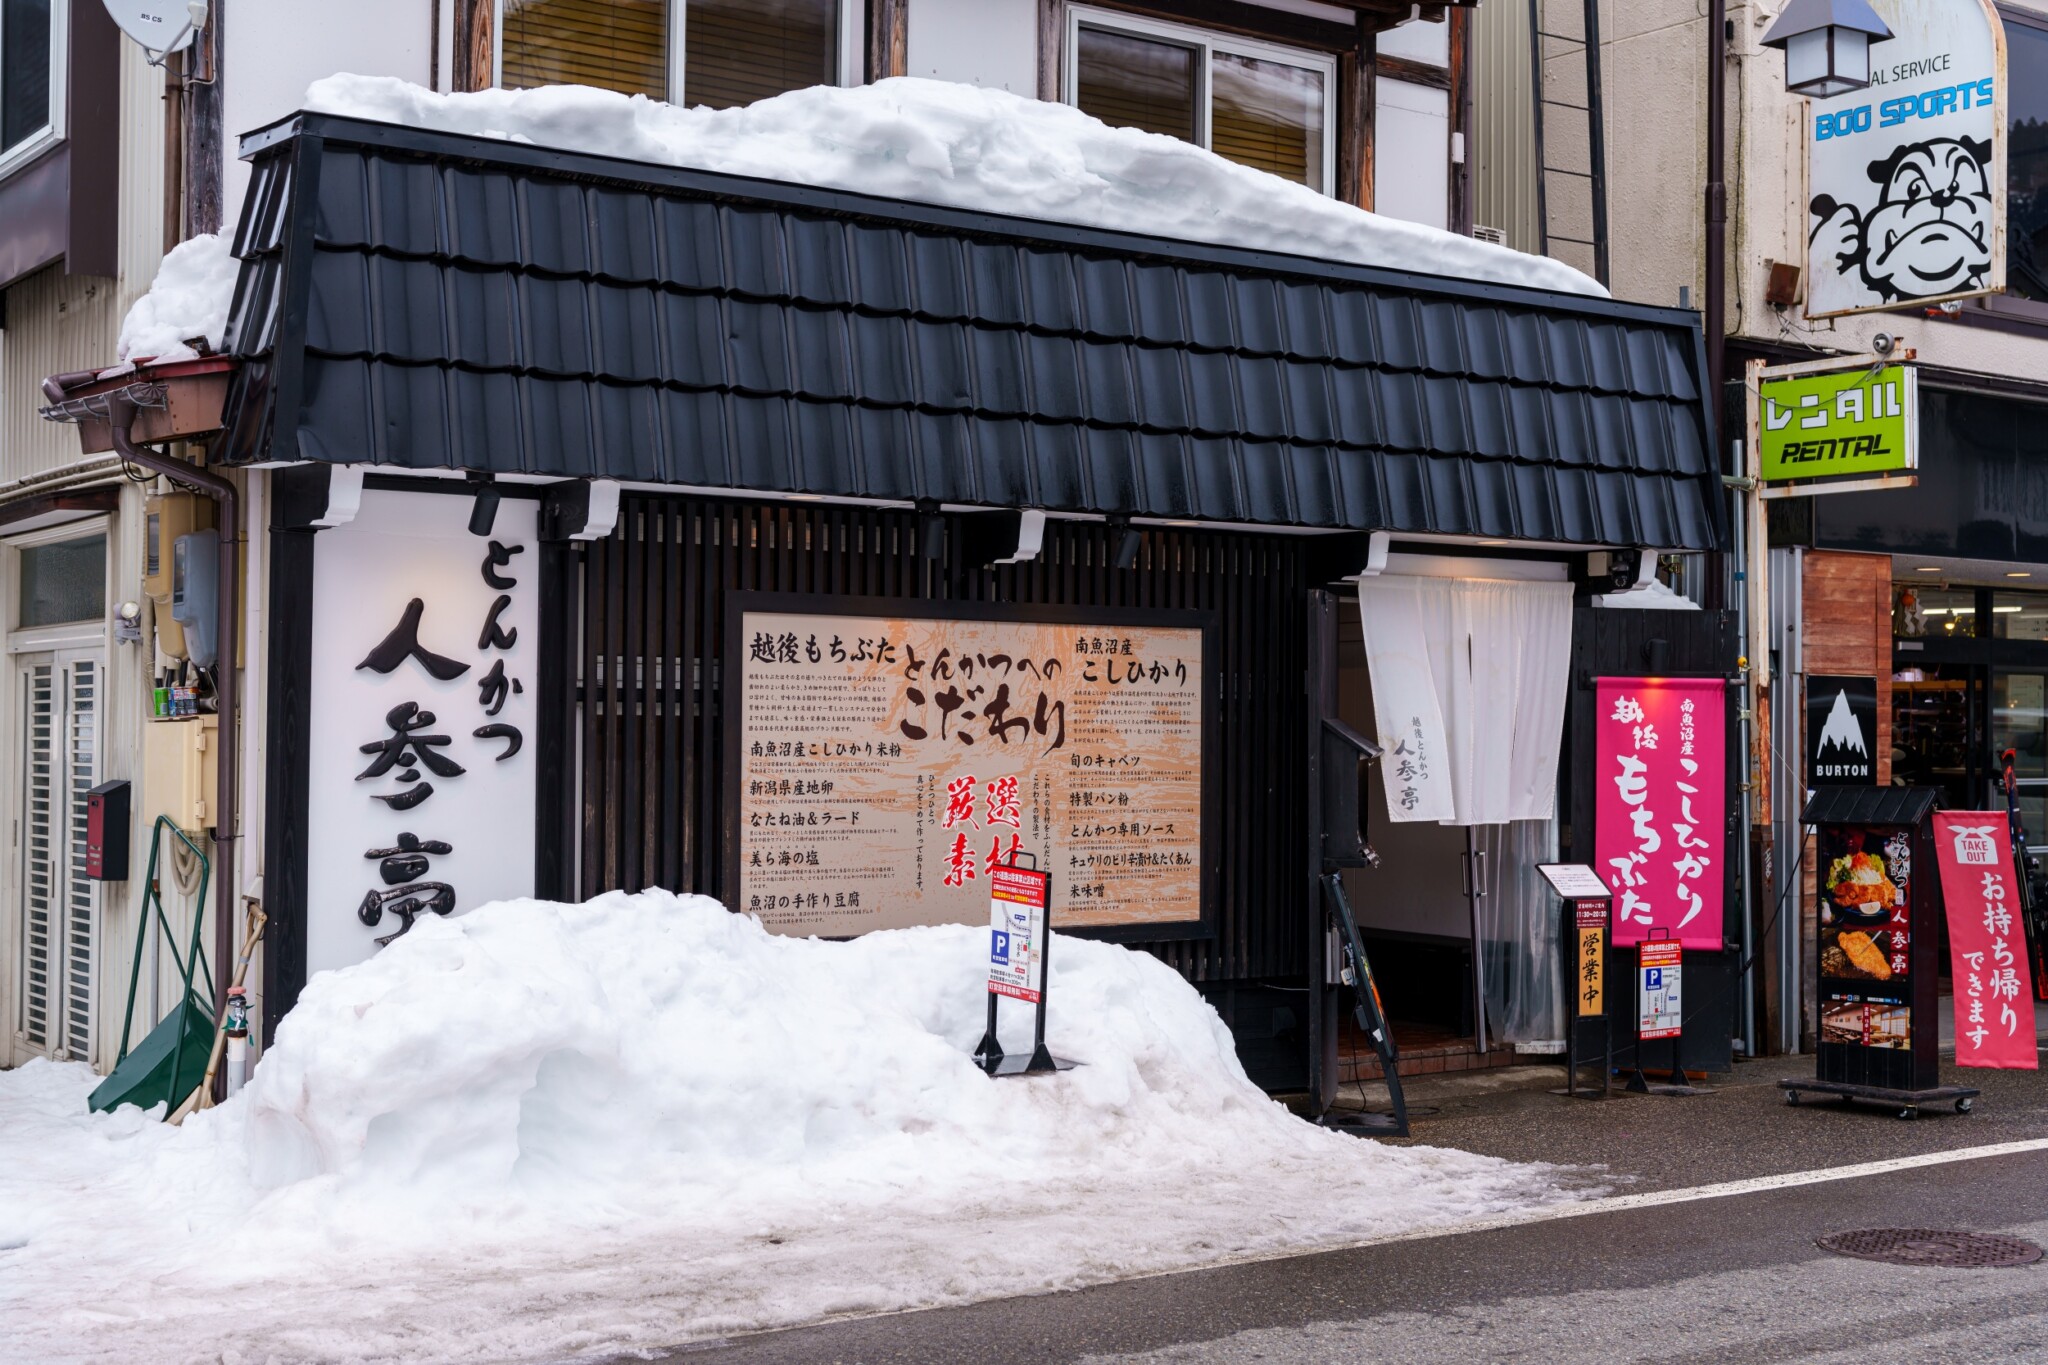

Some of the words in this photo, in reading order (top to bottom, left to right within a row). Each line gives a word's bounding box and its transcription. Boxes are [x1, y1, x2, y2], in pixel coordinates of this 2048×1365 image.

[1869, 70, 1889, 87] AL
[1892, 53, 1951, 82] SERVICE
[1815, 105, 1872, 141] BOO
[1880, 77, 1993, 128] SPORTS
[1766, 381, 1901, 431] レンタル
[1780, 433, 1891, 464] RENTAL
[473, 540, 525, 761] とんかつ
[749, 632, 896, 664] 越後もちぶた
[1075, 636, 1133, 655] 南魚沼産
[904, 644, 1062, 681] とんかつへの
[1082, 658, 1187, 687] こしひかり
[900, 683, 1065, 758] こだわり
[751, 741, 901, 757] 南魚沼産こしひかり米粉
[1071, 753, 1140, 768] 旬のキャベツ
[1412, 716, 1428, 780] 越後とんかつ
[354, 597, 471, 948] 人参亭
[1393, 739, 1419, 810] 人参亭
[1816, 764, 1868, 777] BURTON
[750, 779, 833, 796] 新潟県産地卵
[927, 774, 935, 825] ひとつひとつ
[1069, 791, 1129, 807] 特製パン粉
[1609, 695, 1661, 925] 越後もちぶた
[915, 774, 925, 891] 真心をこめて作っております。
[1071, 822, 1175, 837] とんかつ専用ソース
[1961, 840, 1989, 851] TAKE
[750, 850, 820, 867] 美ら海の塩
[1966, 851, 1987, 862] OUT
[749, 891, 860, 910] 魚沼の手作り豆腐
[1070, 884, 1105, 899] 米味噌
[996, 935, 1007, 953] P
[1891, 910, 1908, 973] 人参亭
[1980, 871, 2022, 1037] お持ち帰り
[1582, 932, 1600, 1009] 営業中
[1650, 970, 1658, 984] P
[1962, 952, 1989, 1050] できます
